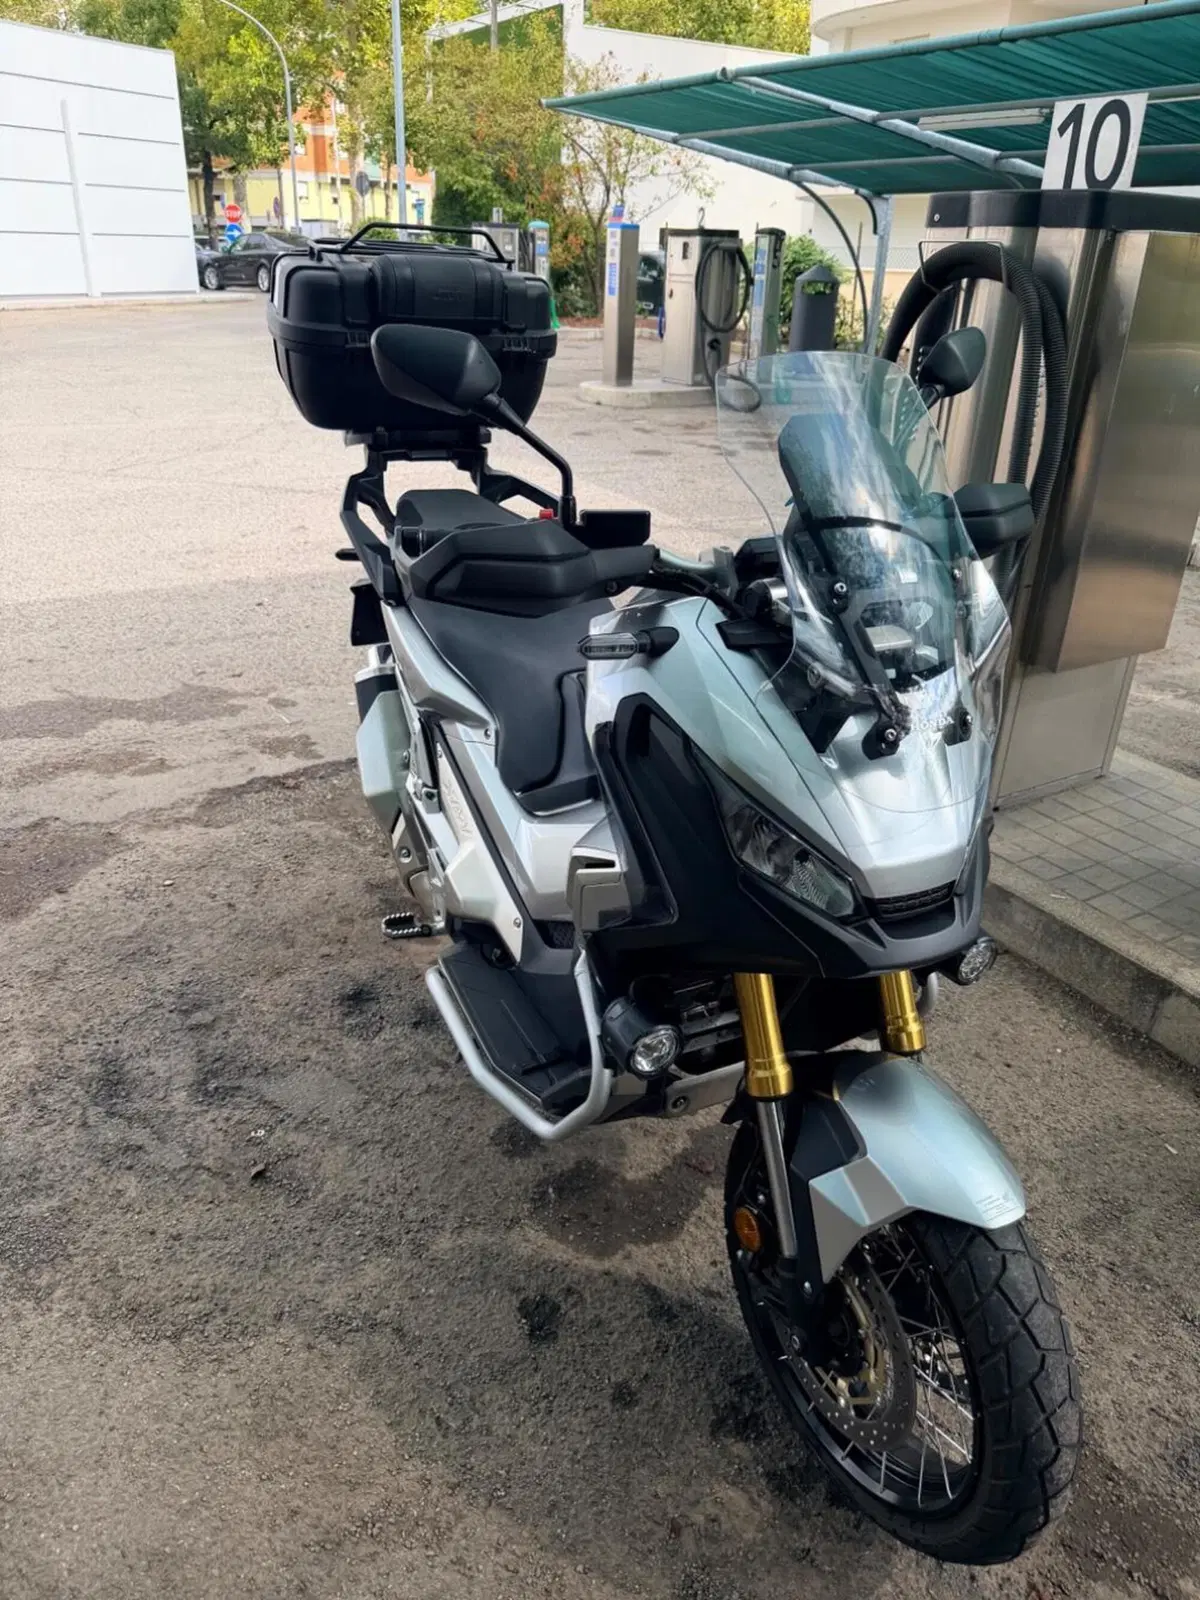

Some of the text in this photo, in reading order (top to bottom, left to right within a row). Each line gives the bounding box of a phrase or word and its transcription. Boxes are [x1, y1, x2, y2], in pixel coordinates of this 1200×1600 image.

[1057, 98, 1131, 190] 10
[225, 208, 242, 218] STOP
[910, 715, 955, 731] HONDA
